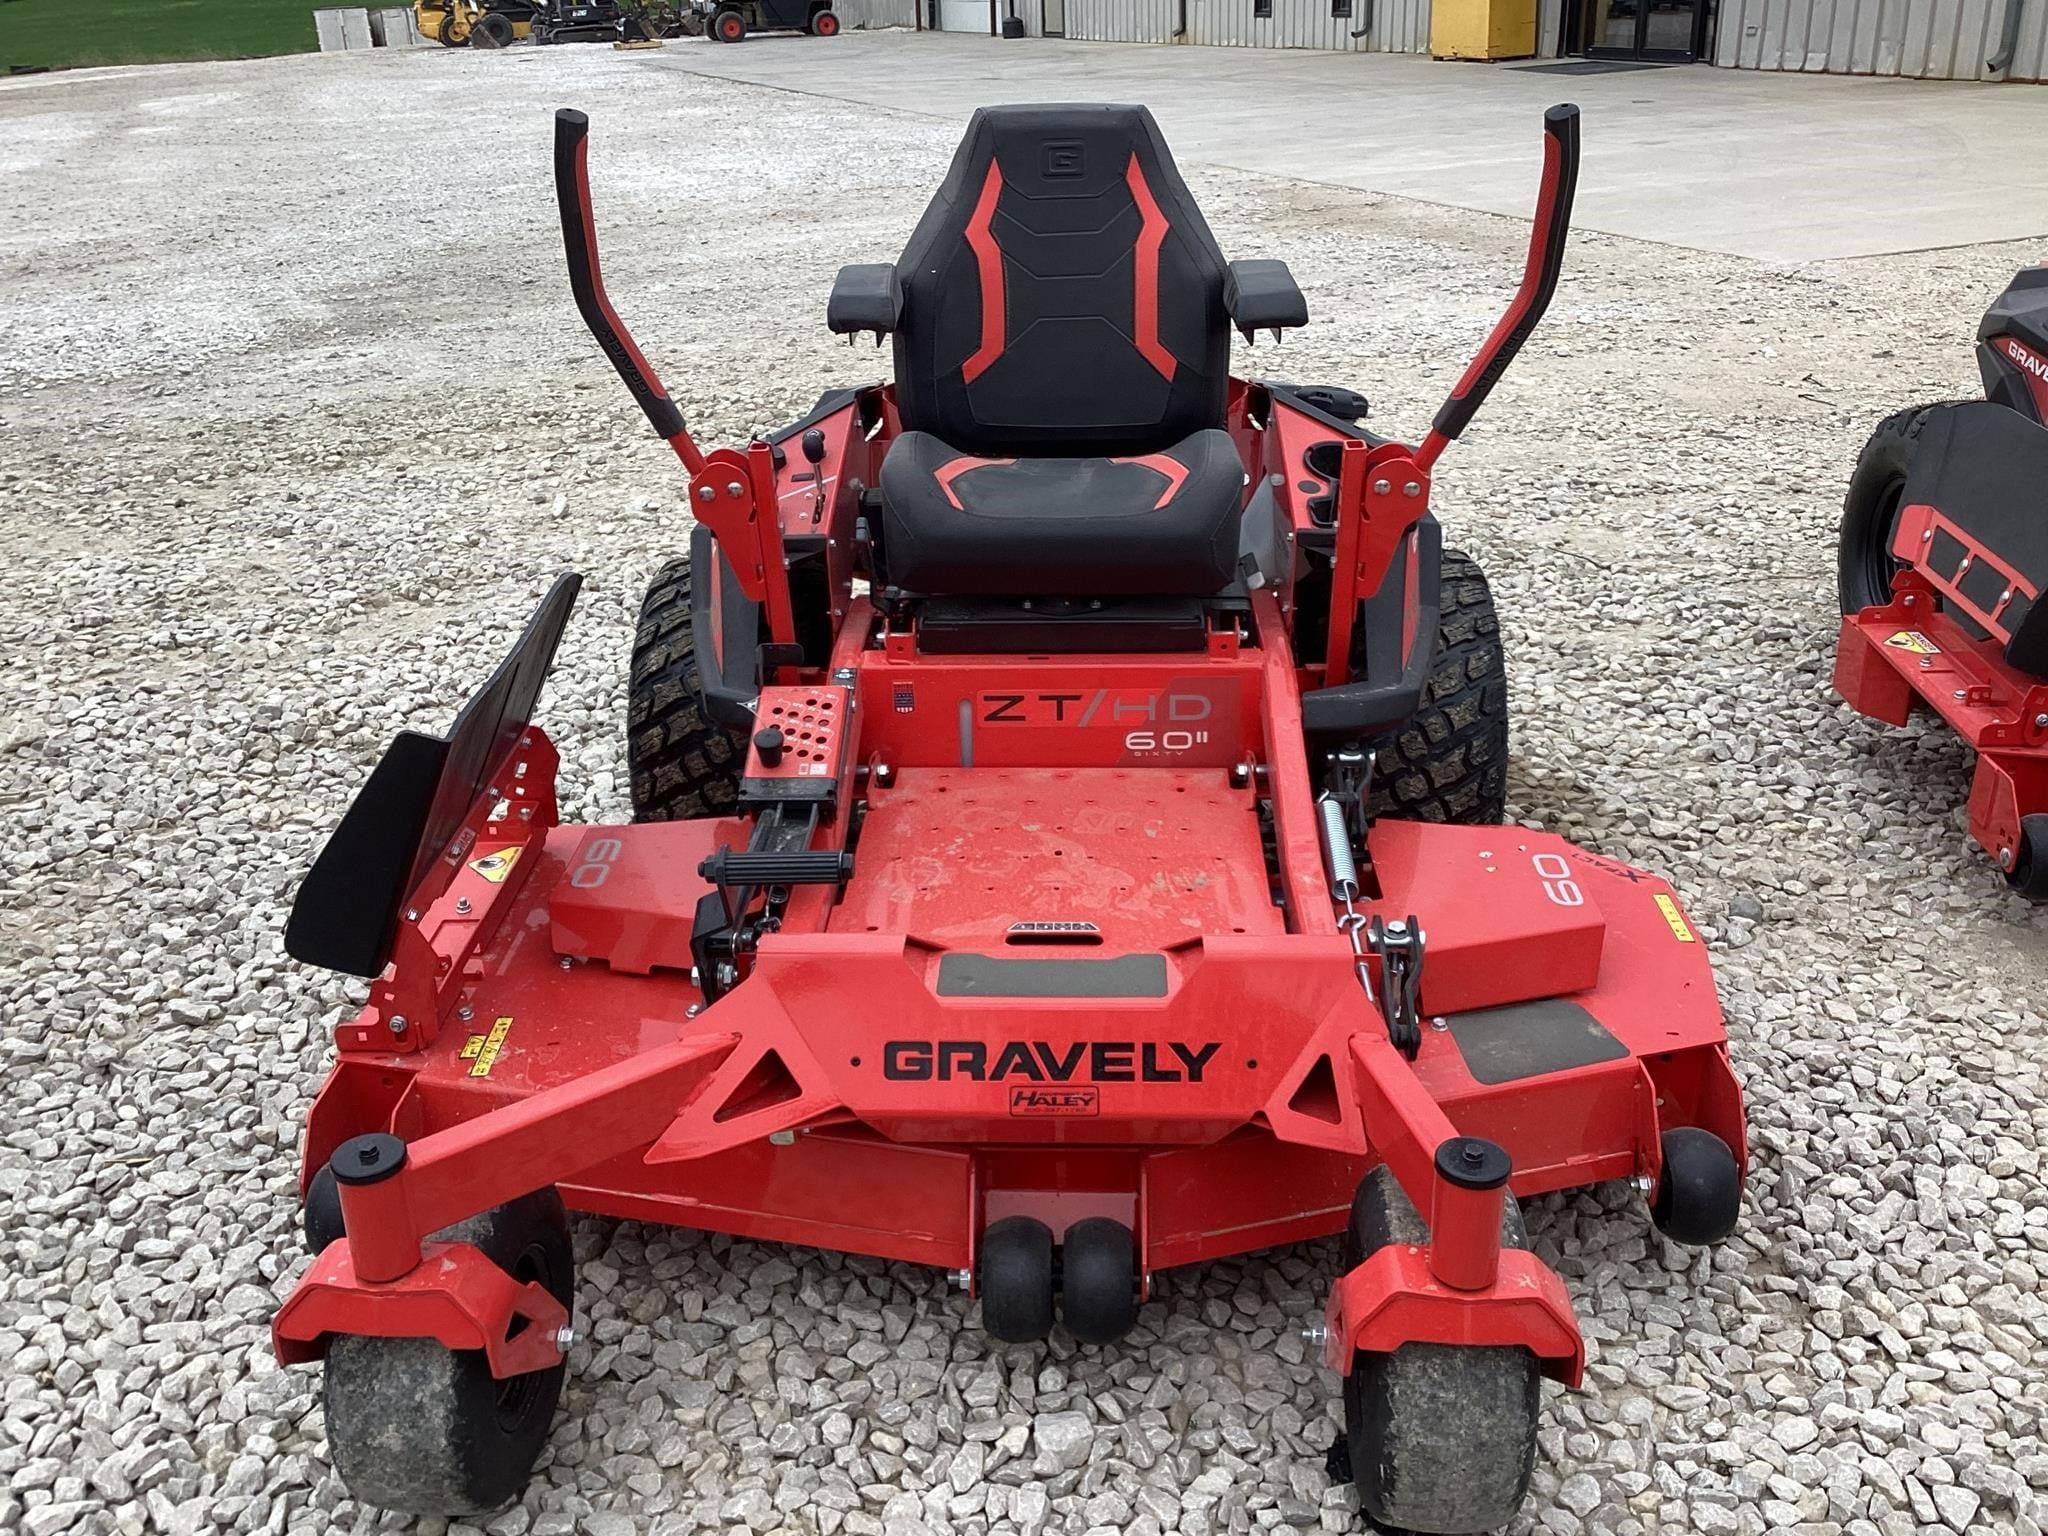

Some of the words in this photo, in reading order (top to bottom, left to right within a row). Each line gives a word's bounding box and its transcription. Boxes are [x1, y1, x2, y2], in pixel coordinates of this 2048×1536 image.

[982, 689, 1213, 727] ZT/HD
[1125, 731, 1209, 751] 60"
[570, 837, 622, 889] 60
[1531, 852, 1585, 907] 60
[883, 1040, 1222, 1082] GRAVELY
[1012, 1090, 1096, 1107] HALEY
